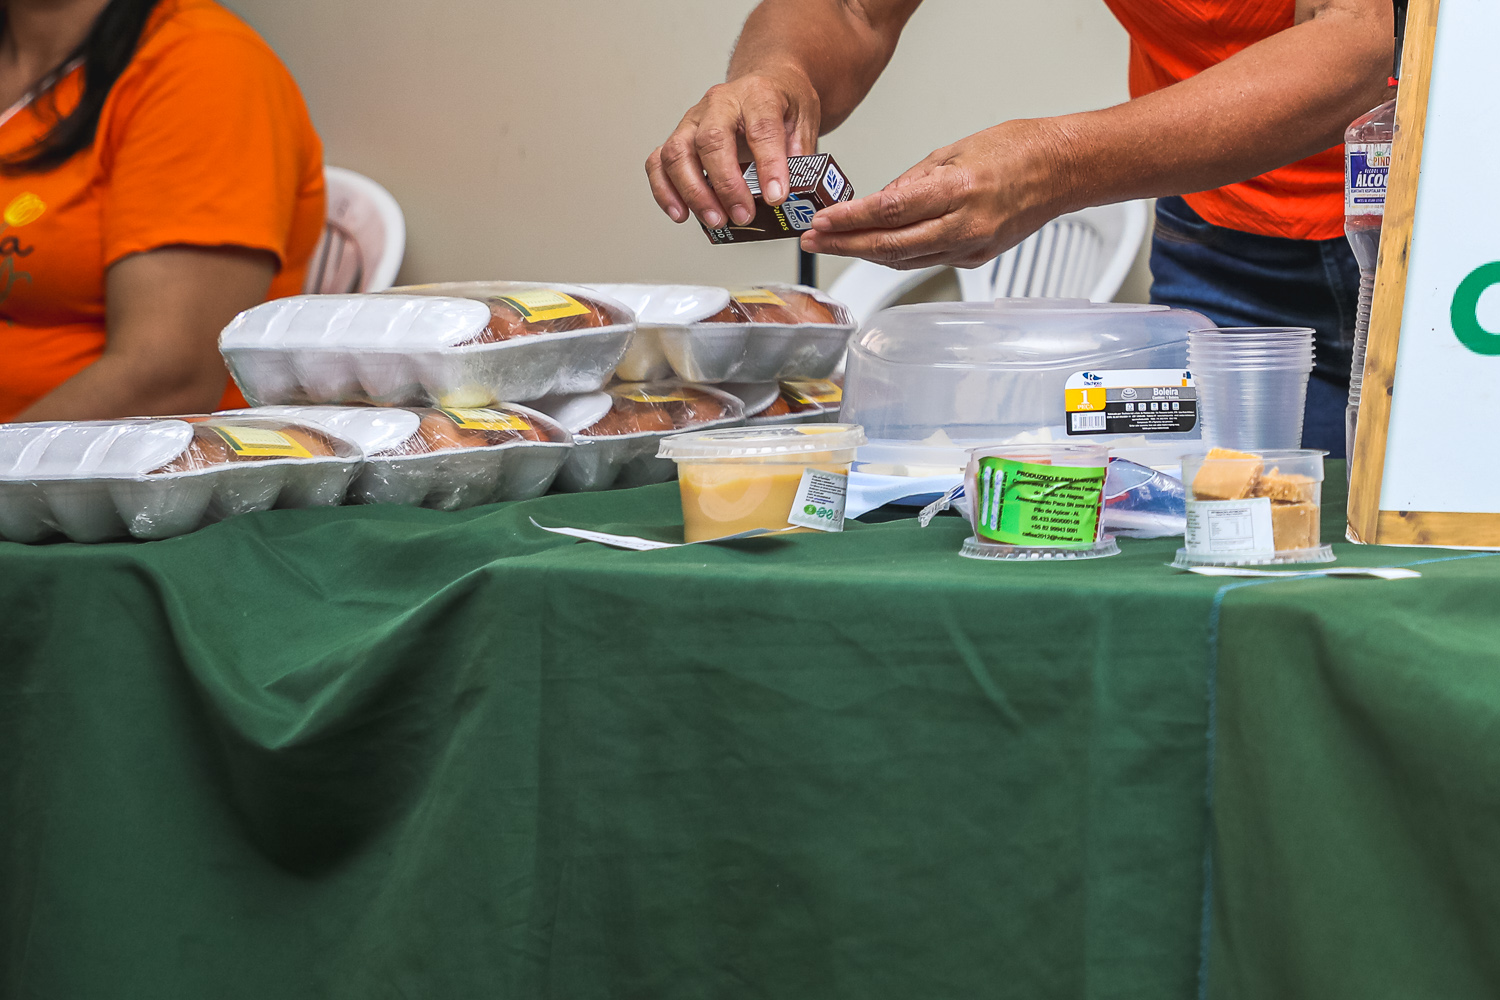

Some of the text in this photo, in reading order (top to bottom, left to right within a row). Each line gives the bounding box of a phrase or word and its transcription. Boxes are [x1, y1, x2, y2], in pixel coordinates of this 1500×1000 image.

[784, 203, 801, 229] THEOTO
[1081, 390, 1090, 405] 1
[1153, 387, 1179, 397] Boleira
